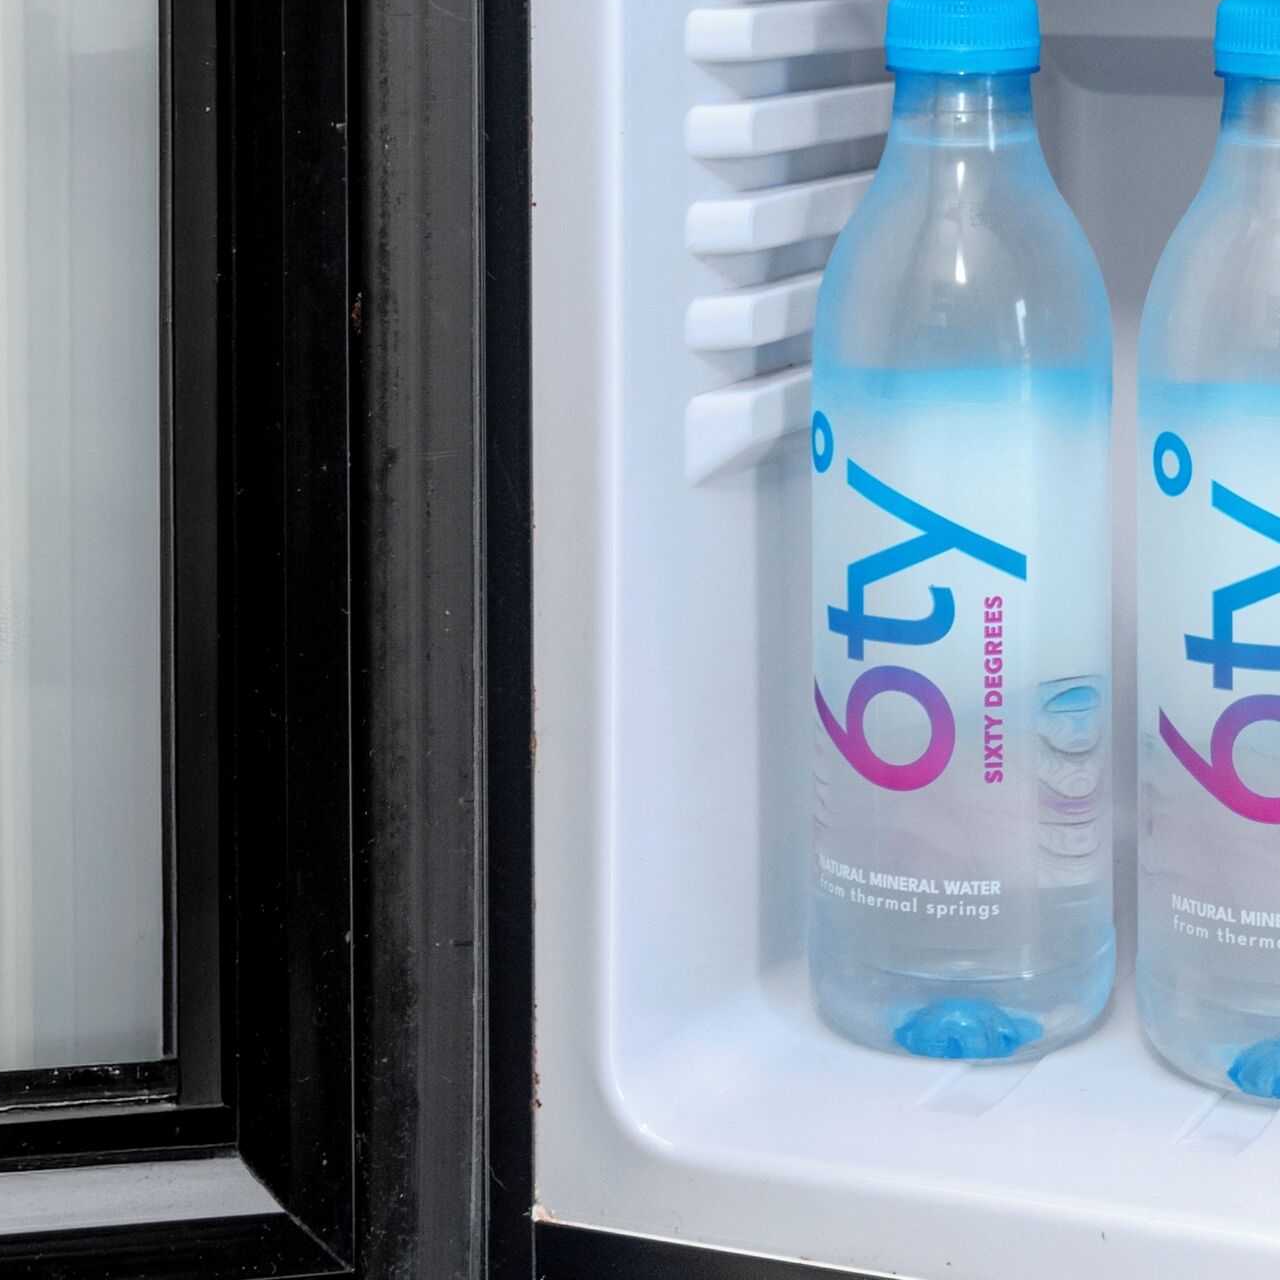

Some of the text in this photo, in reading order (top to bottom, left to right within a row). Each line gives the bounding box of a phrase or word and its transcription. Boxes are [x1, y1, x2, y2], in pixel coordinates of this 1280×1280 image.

[983, 594, 1004, 785] SIXTY DEGREES
[818, 853, 1002, 896] NATURAL MINERAL WATER
[819, 872, 1001, 920] from thermal springs
[1170, 893, 1236, 924] NATURAL
[1173, 914, 1209, 939] from
